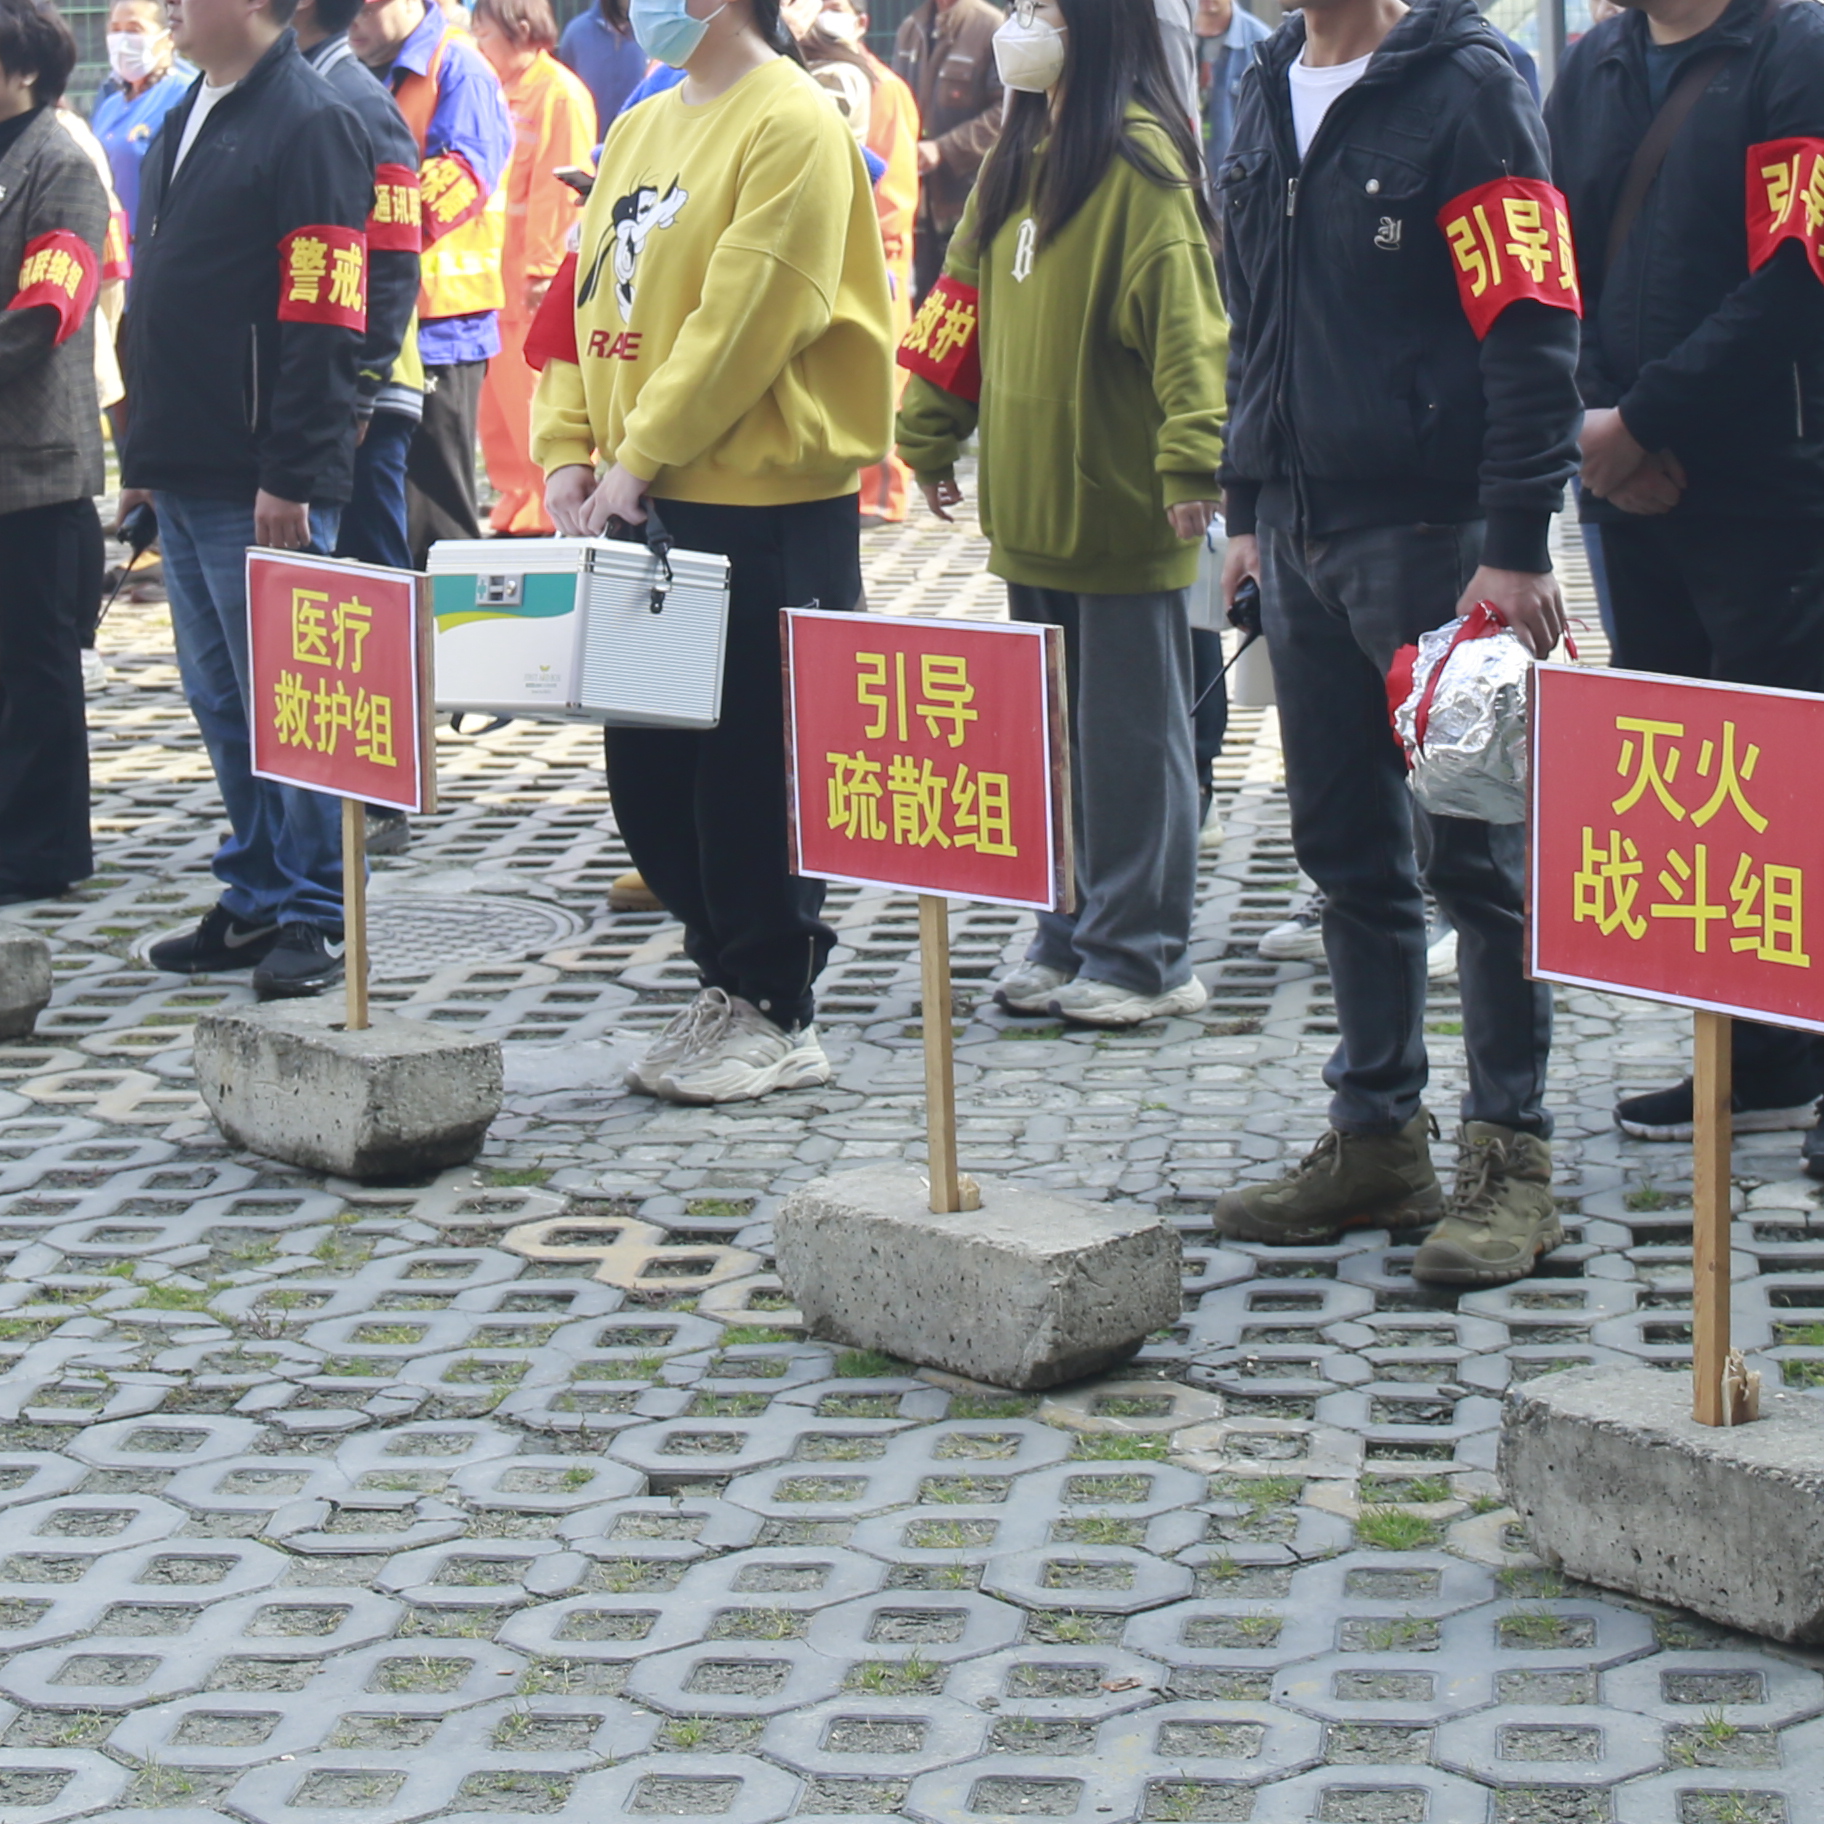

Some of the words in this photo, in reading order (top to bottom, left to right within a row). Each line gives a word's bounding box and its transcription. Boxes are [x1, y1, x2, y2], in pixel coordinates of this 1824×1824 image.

[291, 587, 374, 674] 医疗
[273, 670, 398, 768] 救护组
[854, 650, 979, 749] 引导
[826, 750, 1019, 858] 疏散组
[1611, 715, 1769, 835] 灭火
[1573, 825, 1811, 970] 战斗组
